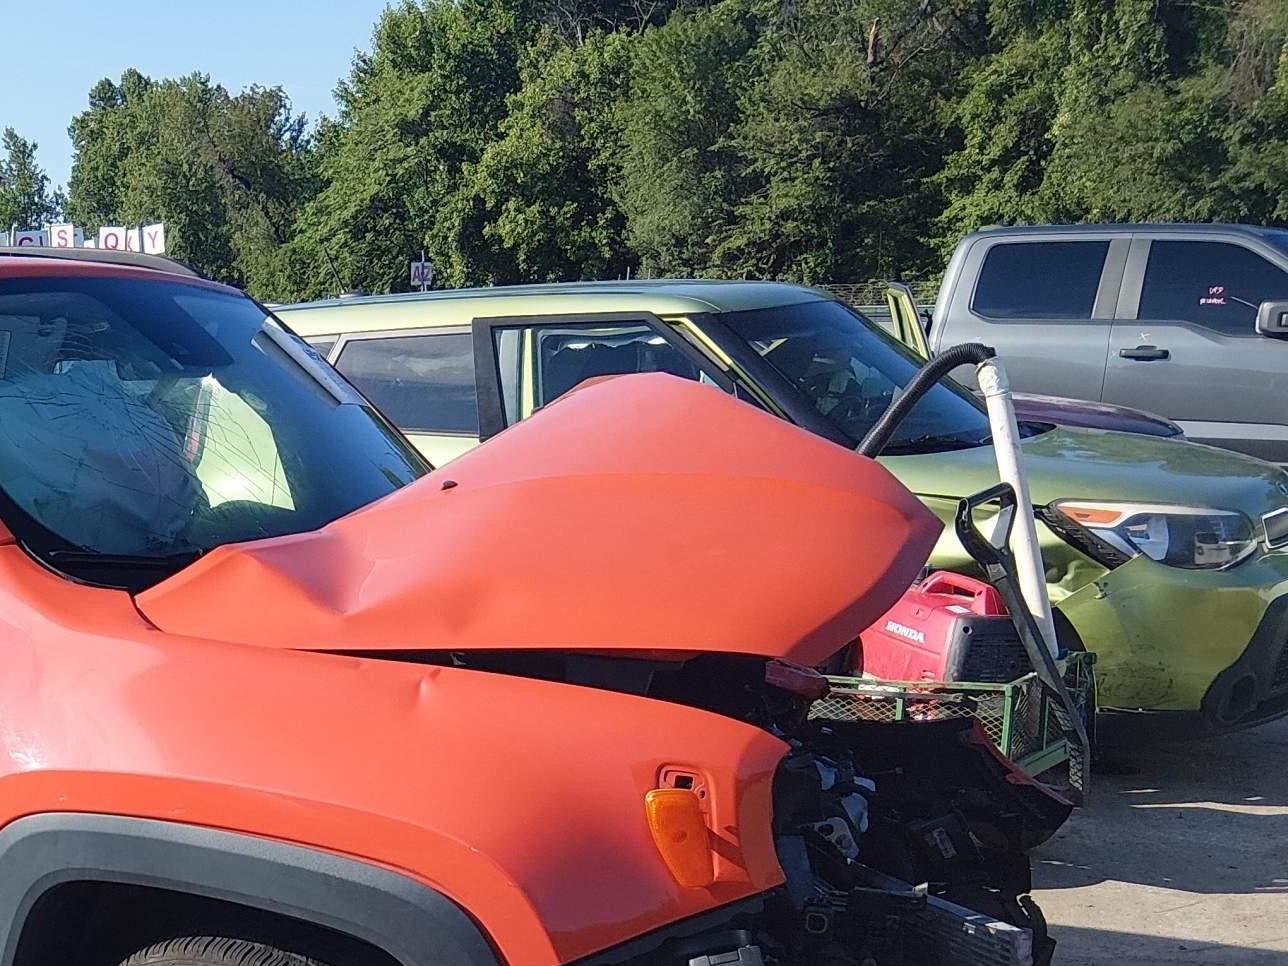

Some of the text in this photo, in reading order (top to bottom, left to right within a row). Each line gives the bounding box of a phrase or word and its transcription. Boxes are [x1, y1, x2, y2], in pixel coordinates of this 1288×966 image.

[57, 229, 68, 248] S
[147, 230, 160, 249] Y
[885, 620, 925, 644] HONDA
